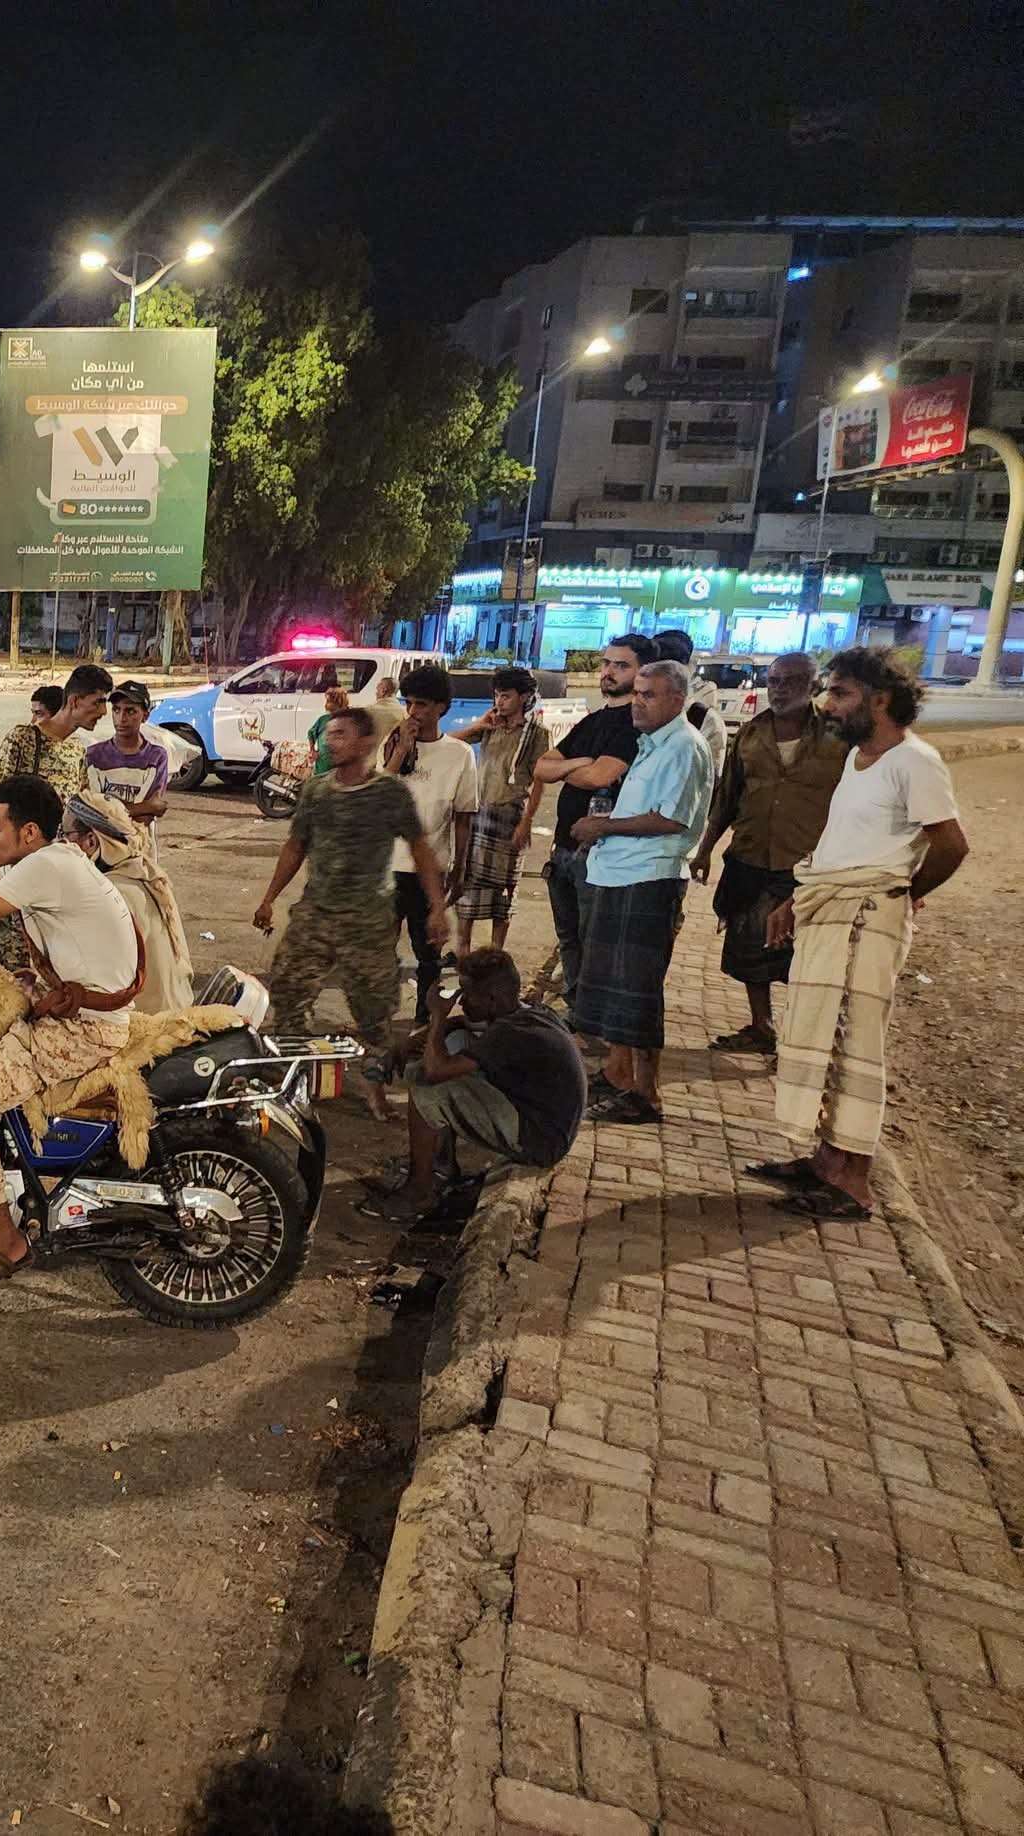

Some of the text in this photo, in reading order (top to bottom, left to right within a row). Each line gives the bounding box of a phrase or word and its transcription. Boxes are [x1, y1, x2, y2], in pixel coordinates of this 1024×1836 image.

[82, 360, 134, 373] استلمها
[72, 376, 144, 391] من أي مكان
